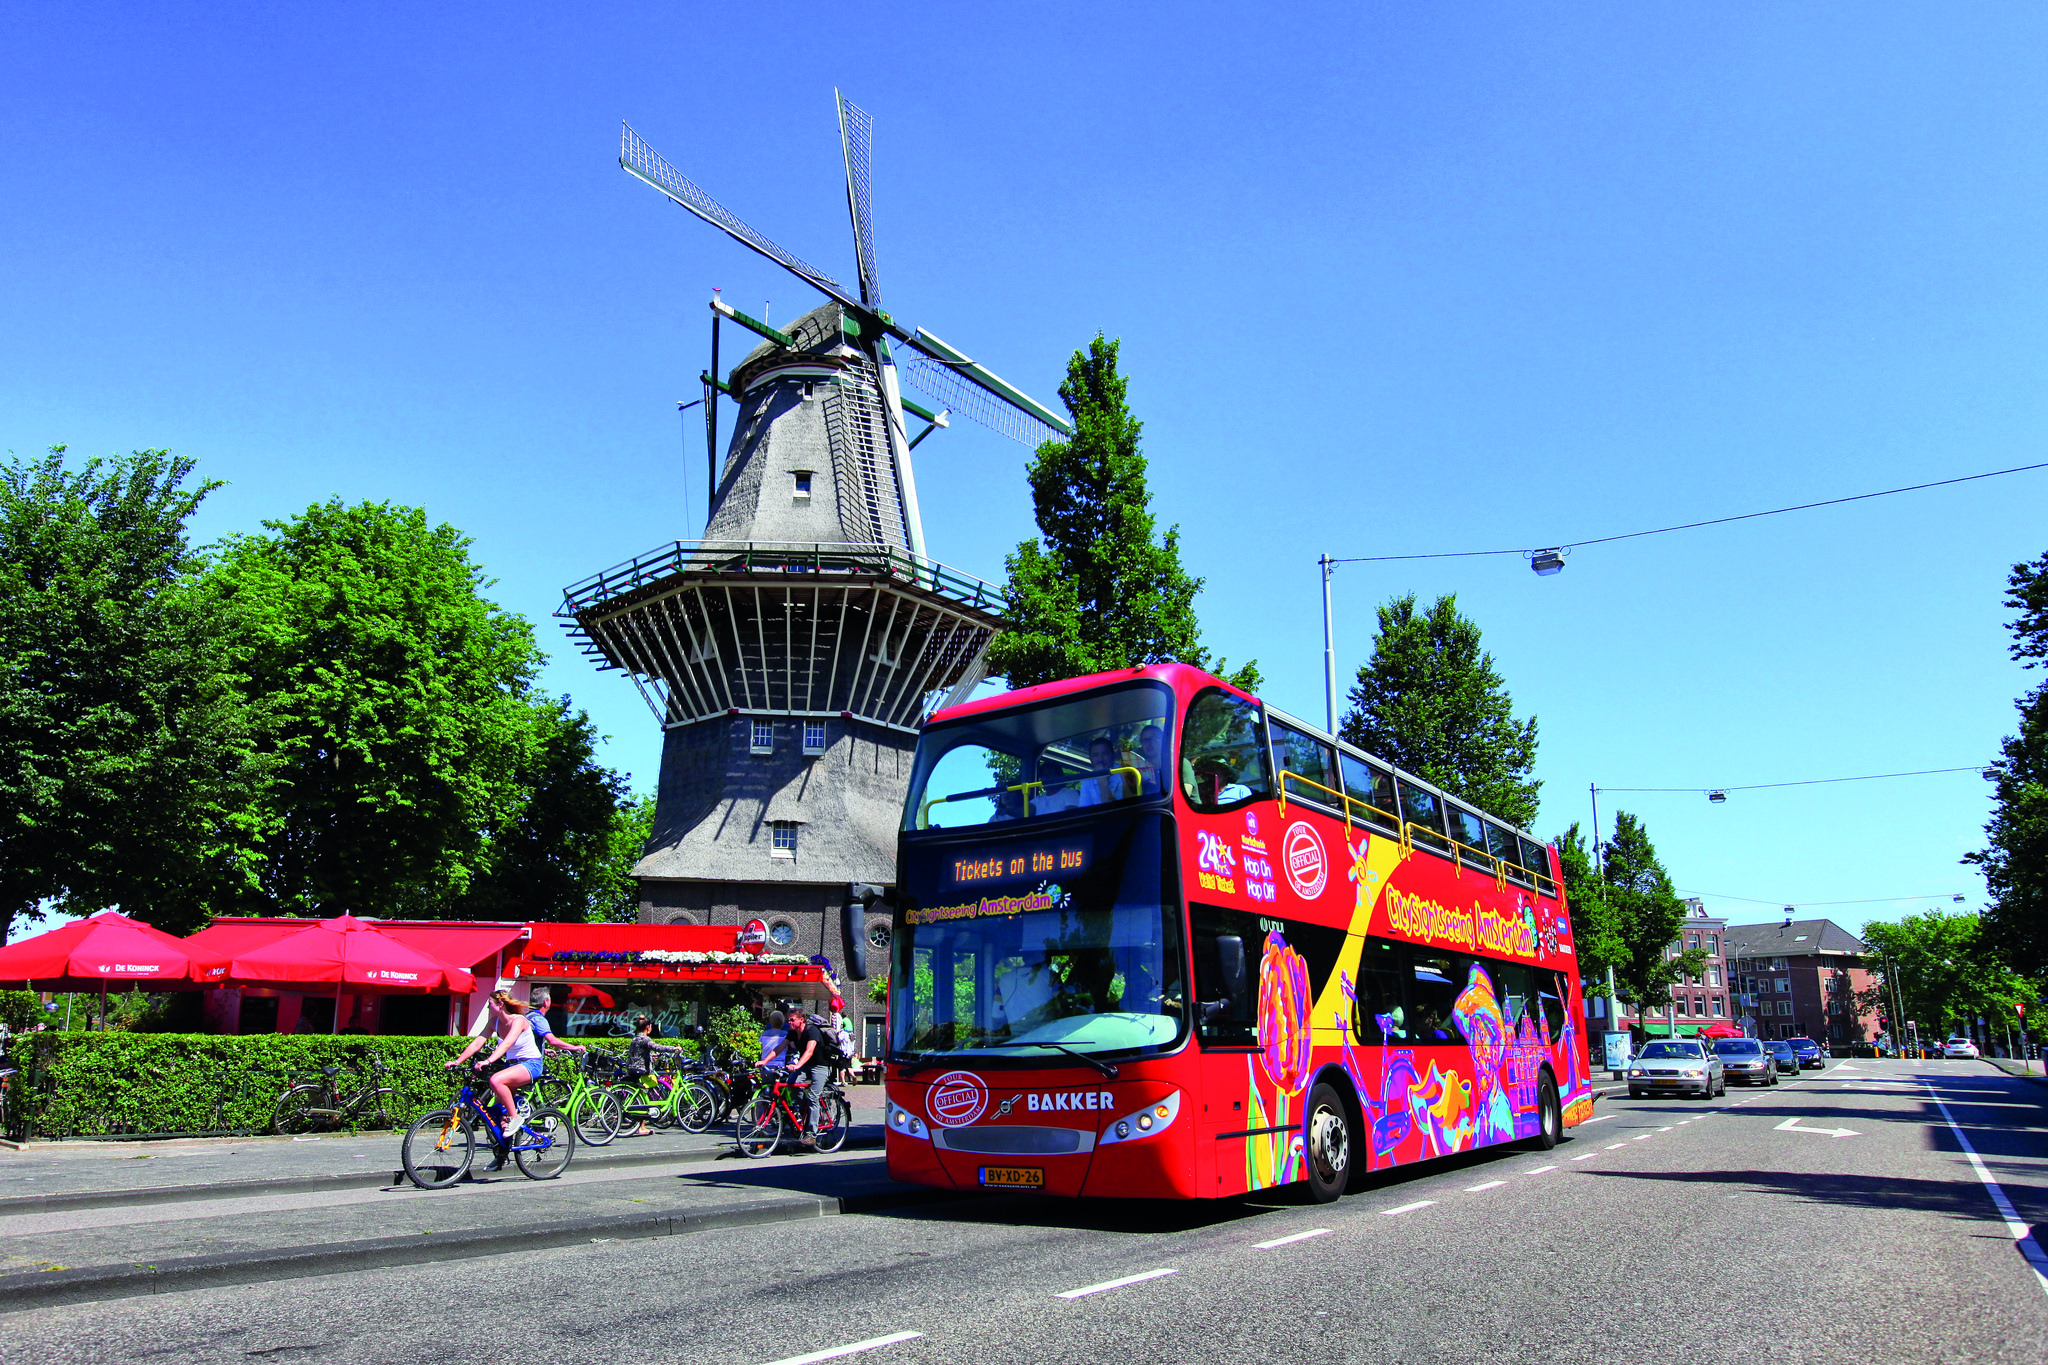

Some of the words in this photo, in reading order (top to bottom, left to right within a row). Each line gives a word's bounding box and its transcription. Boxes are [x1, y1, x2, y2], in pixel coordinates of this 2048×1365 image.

[1198, 832, 1218, 871] 24
[1293, 850, 1319, 869] OFFICIAL
[955, 859, 1003, 882] Tickets
[1010, 857, 1025, 875] on
[1032, 852, 1053, 872] the
[1061, 850, 1083, 869] bus
[1243, 856, 1260, 878] Hop
[1260, 859, 1272, 878] On
[1246, 879, 1263, 900] Hop
[1263, 881, 1275, 900] Off
[1302, 871, 1325, 896] AMSTERDAM
[978, 891, 1053, 916] Amsterdam
[1474, 900, 1535, 958] Amsterdam
[115, 964, 126, 972] DE
[127, 964, 160, 972] KONINCK
[380, 970, 390, 979] DE
[390, 971, 418, 980] KONINCK
[943, 1074, 963, 1083] TOUR
[936, 1090, 977, 1107] OFFICIAL
[1027, 1092, 1114, 1111] BAKKER
[935, 1113, 944, 1122] OF
[945, 1105, 982, 1125] AMSTERDAM
[988, 1169, 1040, 1183] BV-XD-26
